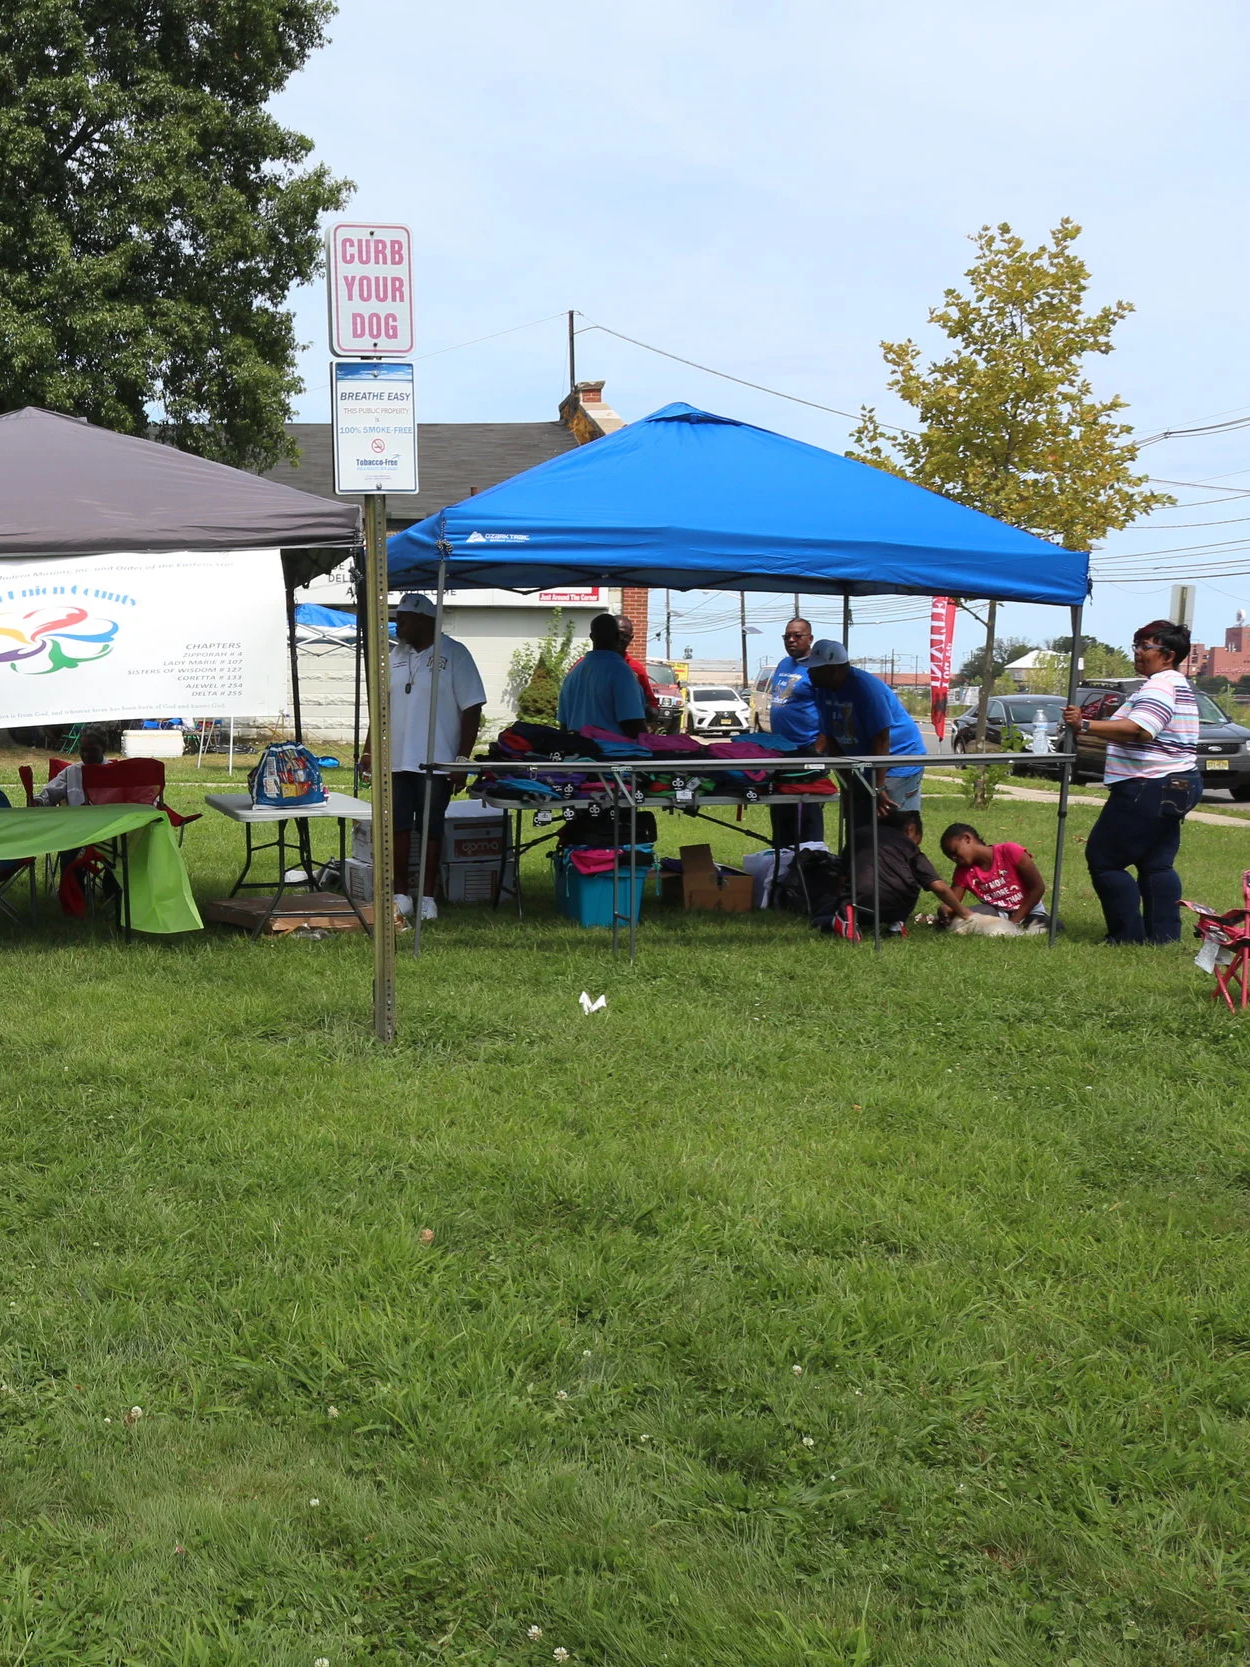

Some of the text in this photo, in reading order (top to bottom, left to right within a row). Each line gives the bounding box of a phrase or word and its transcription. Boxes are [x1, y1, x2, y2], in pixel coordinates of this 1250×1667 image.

[341, 237, 404, 265] CURB
[343, 275, 405, 302] YOUR
[351, 312, 398, 339] DOG
[340, 391, 411, 401] BREATHE EASY
[381, 407, 409, 415] PROPERTY
[340, 426, 413, 434] 100% SMOKE-FREE
[552, 593, 570, 601] Around
[570, 593, 581, 601] The
[581, 593, 598, 601] Corner
[186, 642, 242, 650] CHAPTERS
[989, 877, 1006, 890] MOM
[991, 887, 1010, 899] MORE
[1005, 891, 1024, 905] THAN
